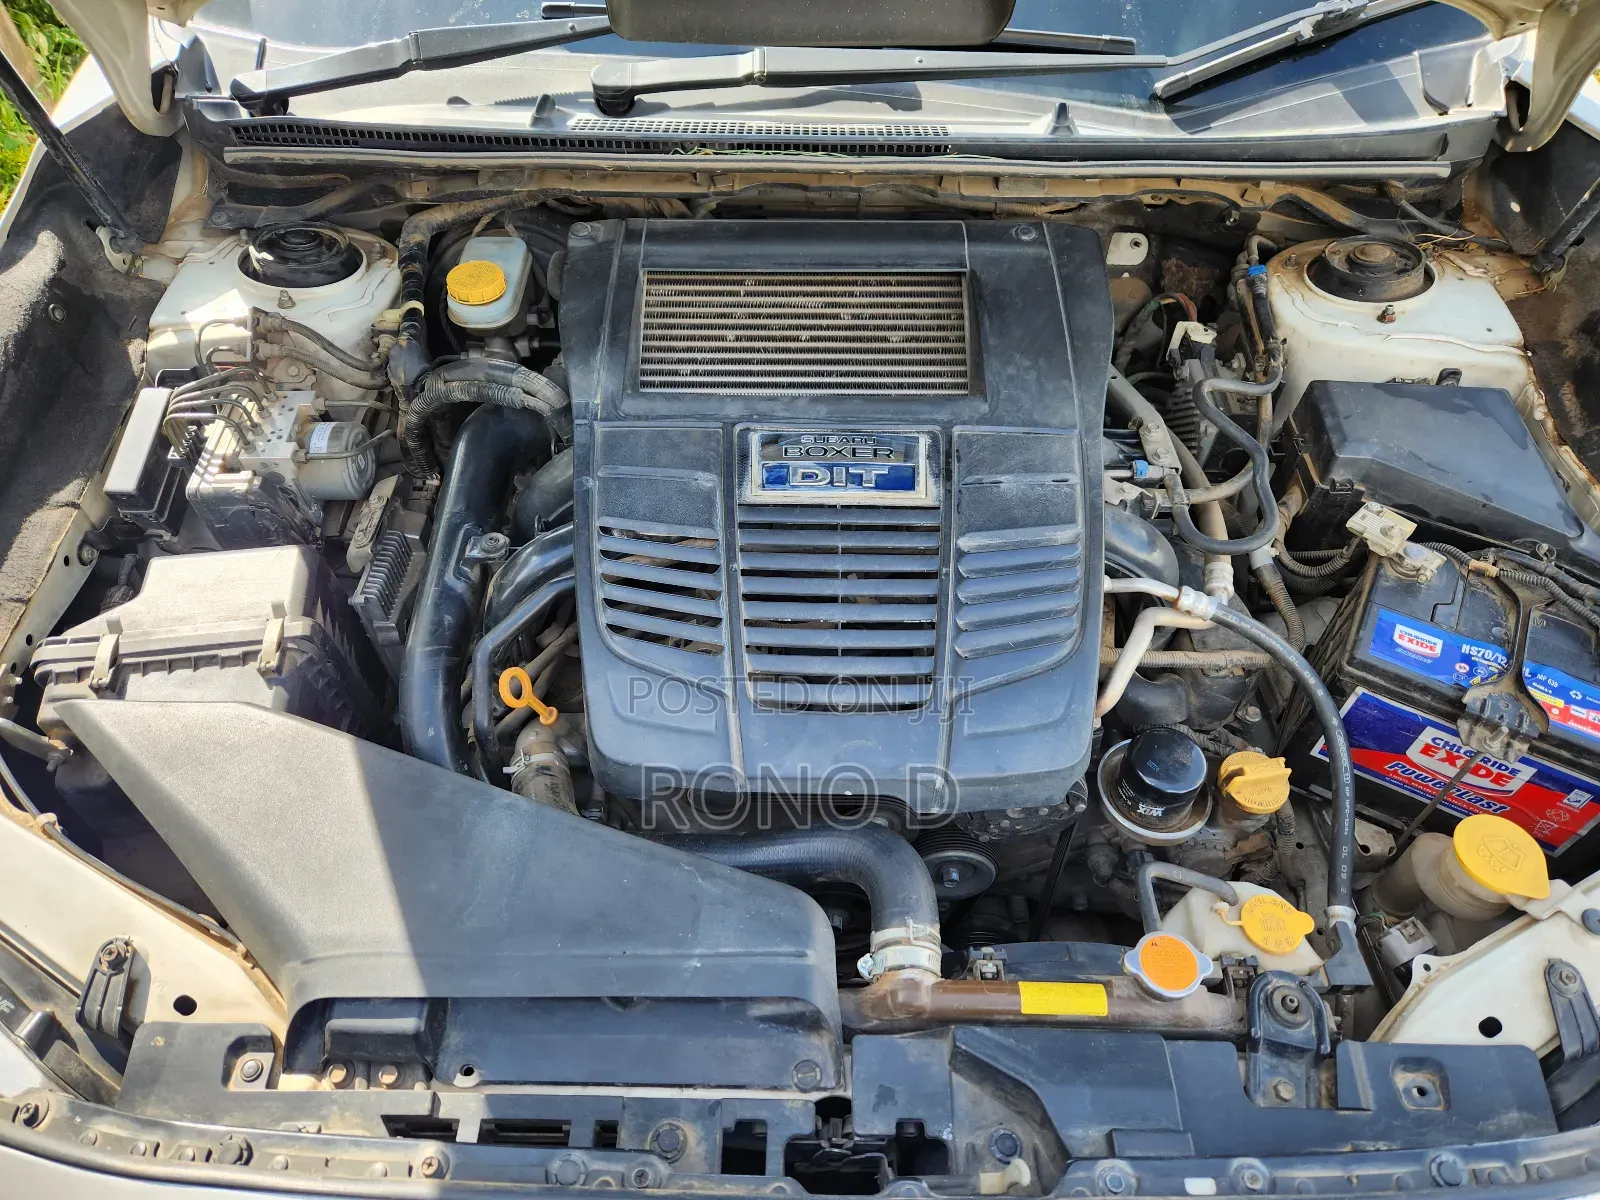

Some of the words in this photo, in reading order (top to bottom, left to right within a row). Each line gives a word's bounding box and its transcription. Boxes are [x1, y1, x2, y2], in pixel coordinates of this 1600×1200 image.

[801, 435, 876, 445] SUBARU
[783, 446, 895, 459] BOXER
[789, 466, 888, 486] DIT
[1397, 633, 1437, 653] EXIDE
[1137, 805, 1162, 816] WIX
